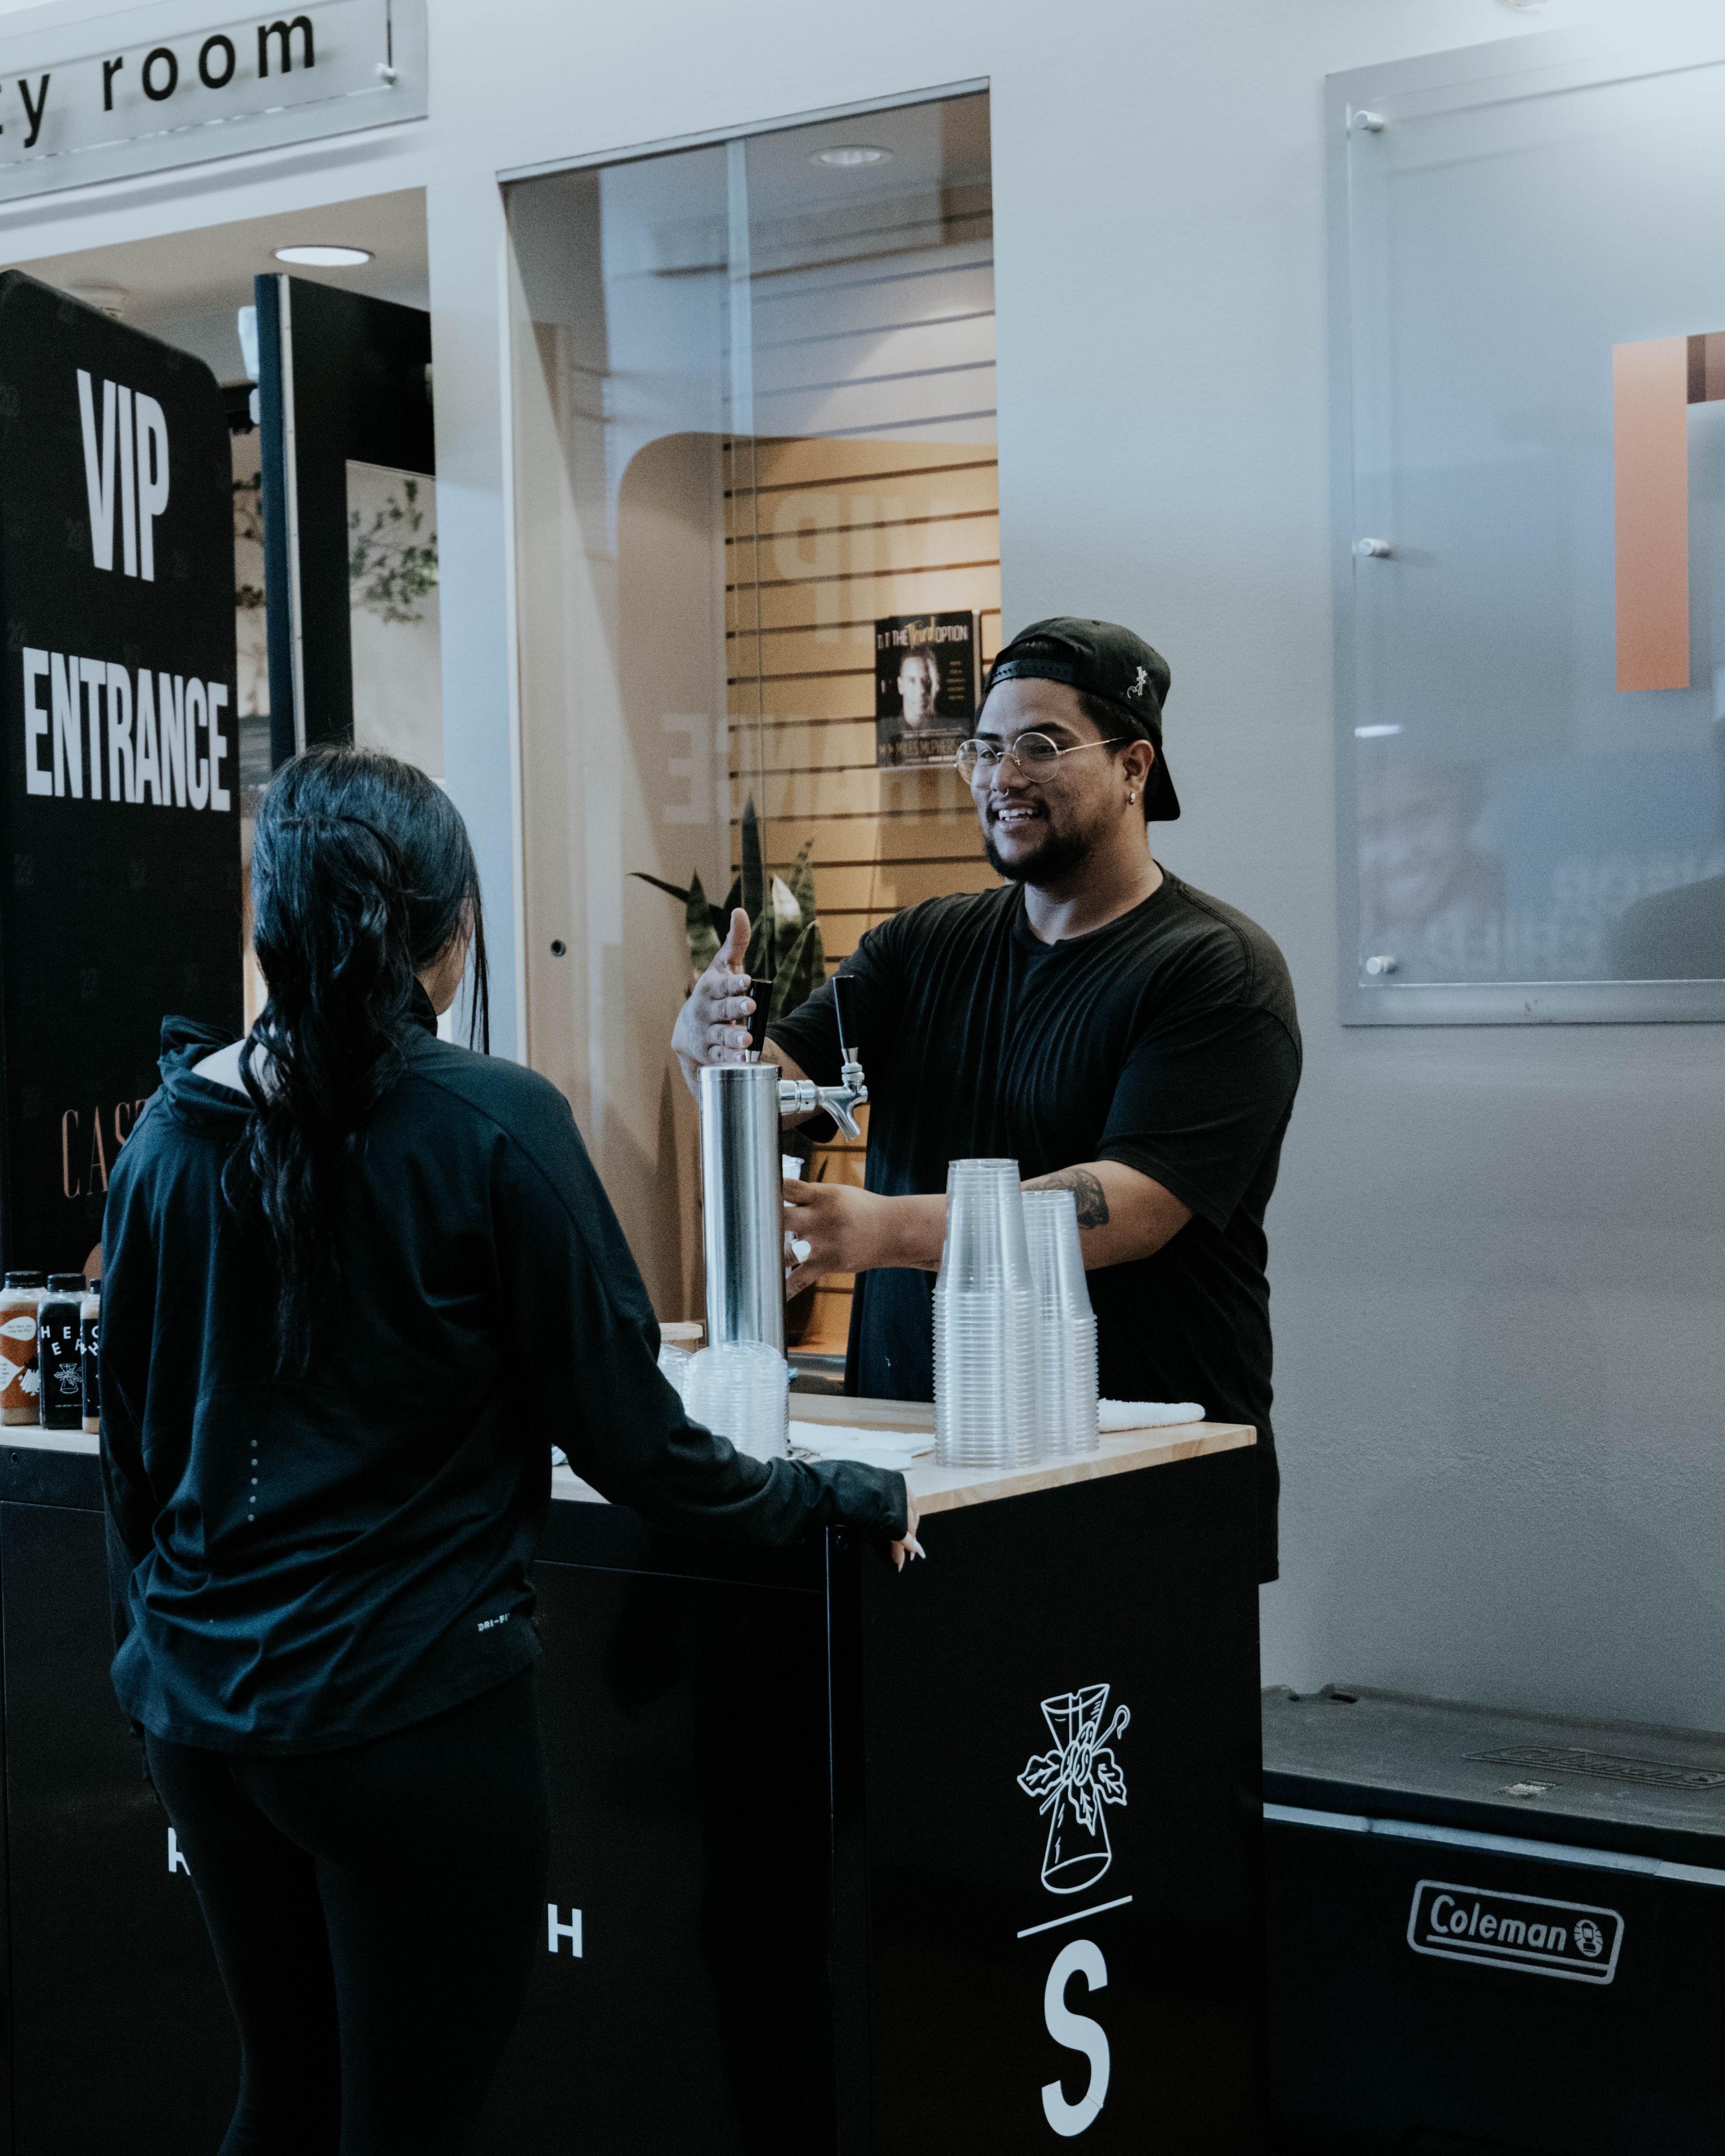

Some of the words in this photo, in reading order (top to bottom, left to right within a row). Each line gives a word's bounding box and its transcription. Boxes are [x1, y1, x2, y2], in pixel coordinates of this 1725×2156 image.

[0, 74, 51, 149] y
[102, 15, 315, 112] room
[76, 368, 170, 582] VIP
[935, 624, 969, 644] OPTION
[22, 647, 231, 812] ENTRANCE
[61, 1099, 148, 1199] CAS
[1430, 1894, 1568, 1953] Coleman
[1041, 1939, 1110, 2137] S
